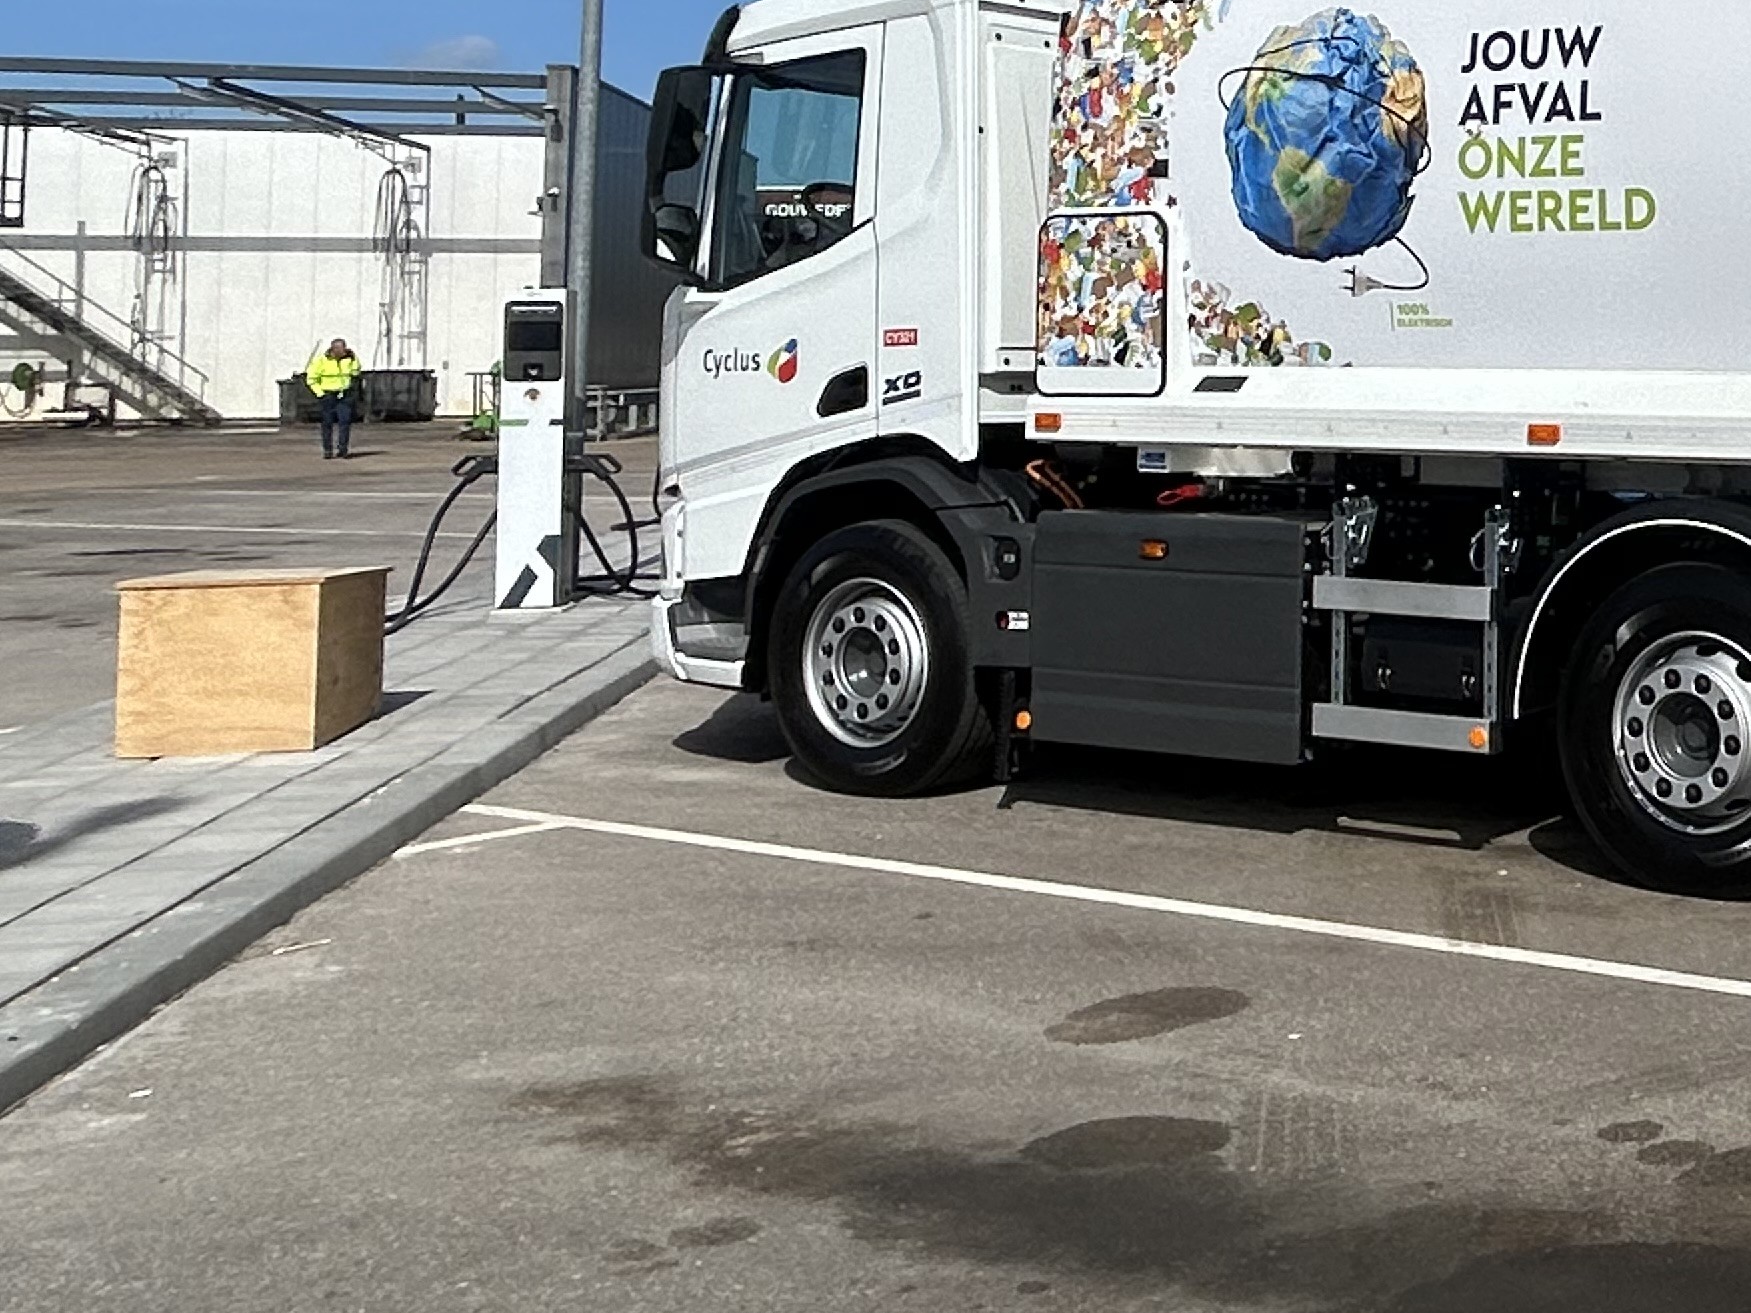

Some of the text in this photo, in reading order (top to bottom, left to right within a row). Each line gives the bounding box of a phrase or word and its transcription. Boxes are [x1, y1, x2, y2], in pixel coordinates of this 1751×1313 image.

[1461, 25, 1603, 73] JOUW
[1458, 79, 1602, 125] AFVAL
[1457, 189, 1656, 234] WERELD
[1397, 303, 1429, 315] 100%
[703, 347, 760, 379] Cyclus
